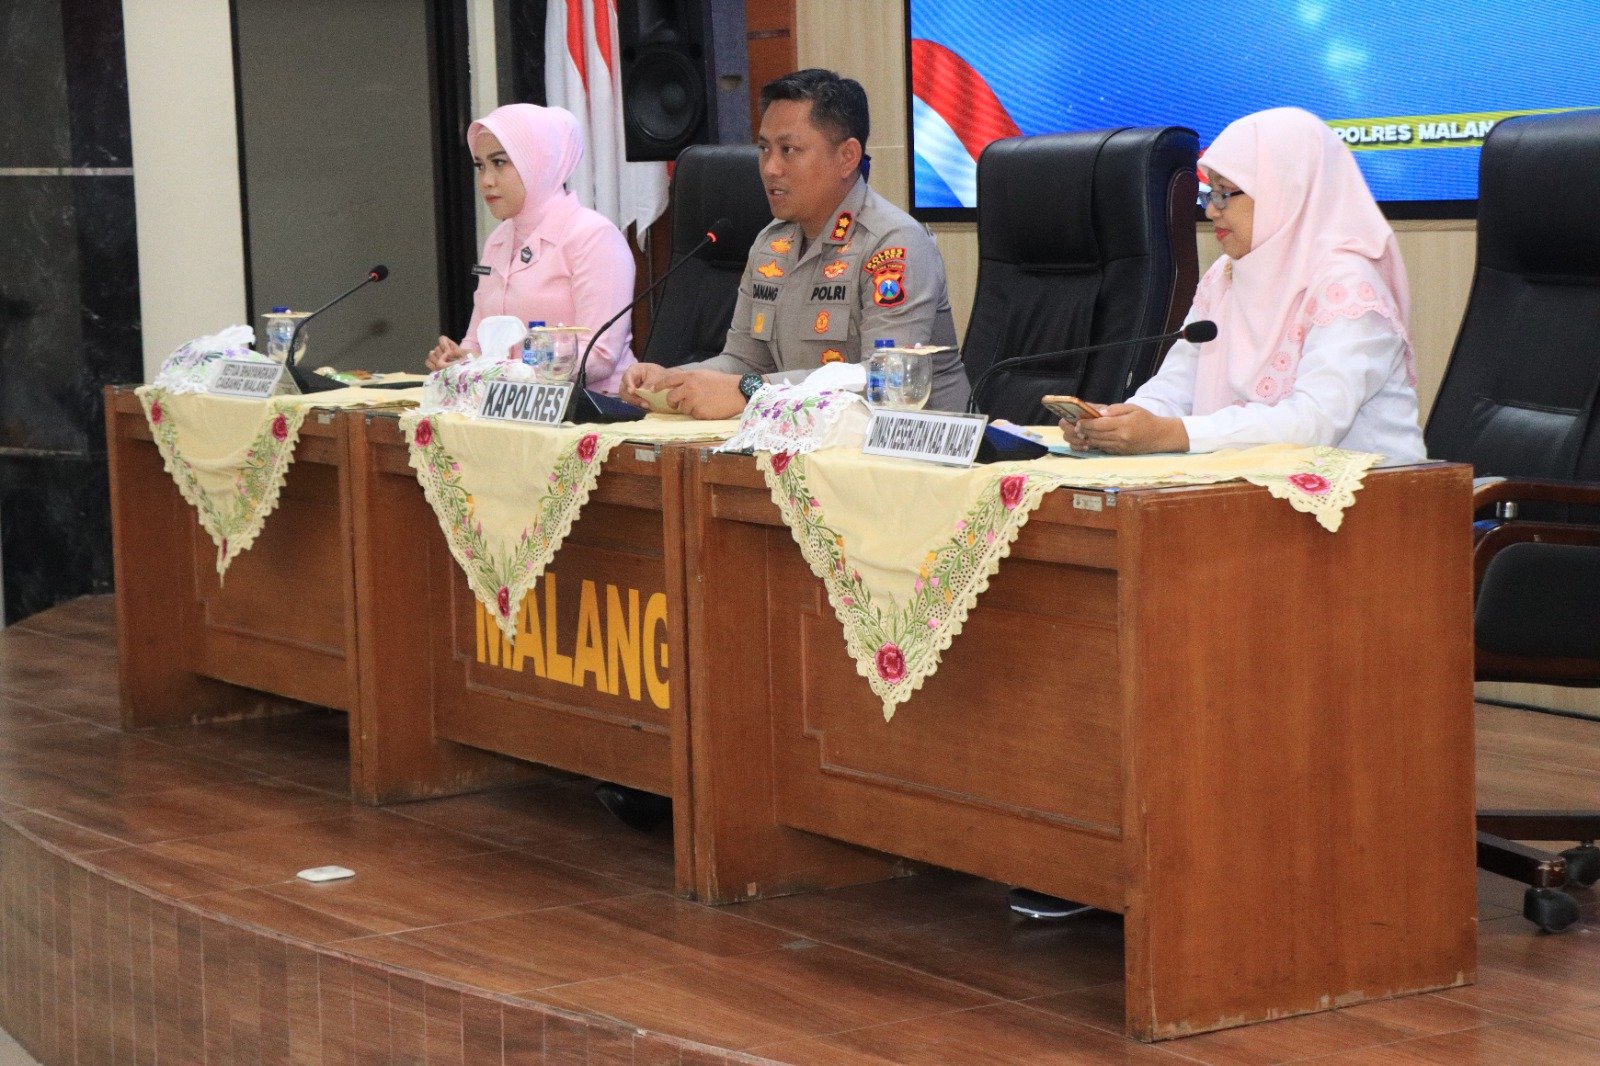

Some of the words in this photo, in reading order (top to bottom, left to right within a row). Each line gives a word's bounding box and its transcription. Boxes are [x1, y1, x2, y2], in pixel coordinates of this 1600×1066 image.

[1332, 125, 1411, 143] POLRES
[867, 249, 903, 269] POLRES
[753, 284, 779, 301] DANANG
[811, 286, 846, 301] POLRI
[482, 382, 564, 423] KAPOLRES
[941, 423, 977, 458] MALANG
[476, 572, 670, 710] MALANG
